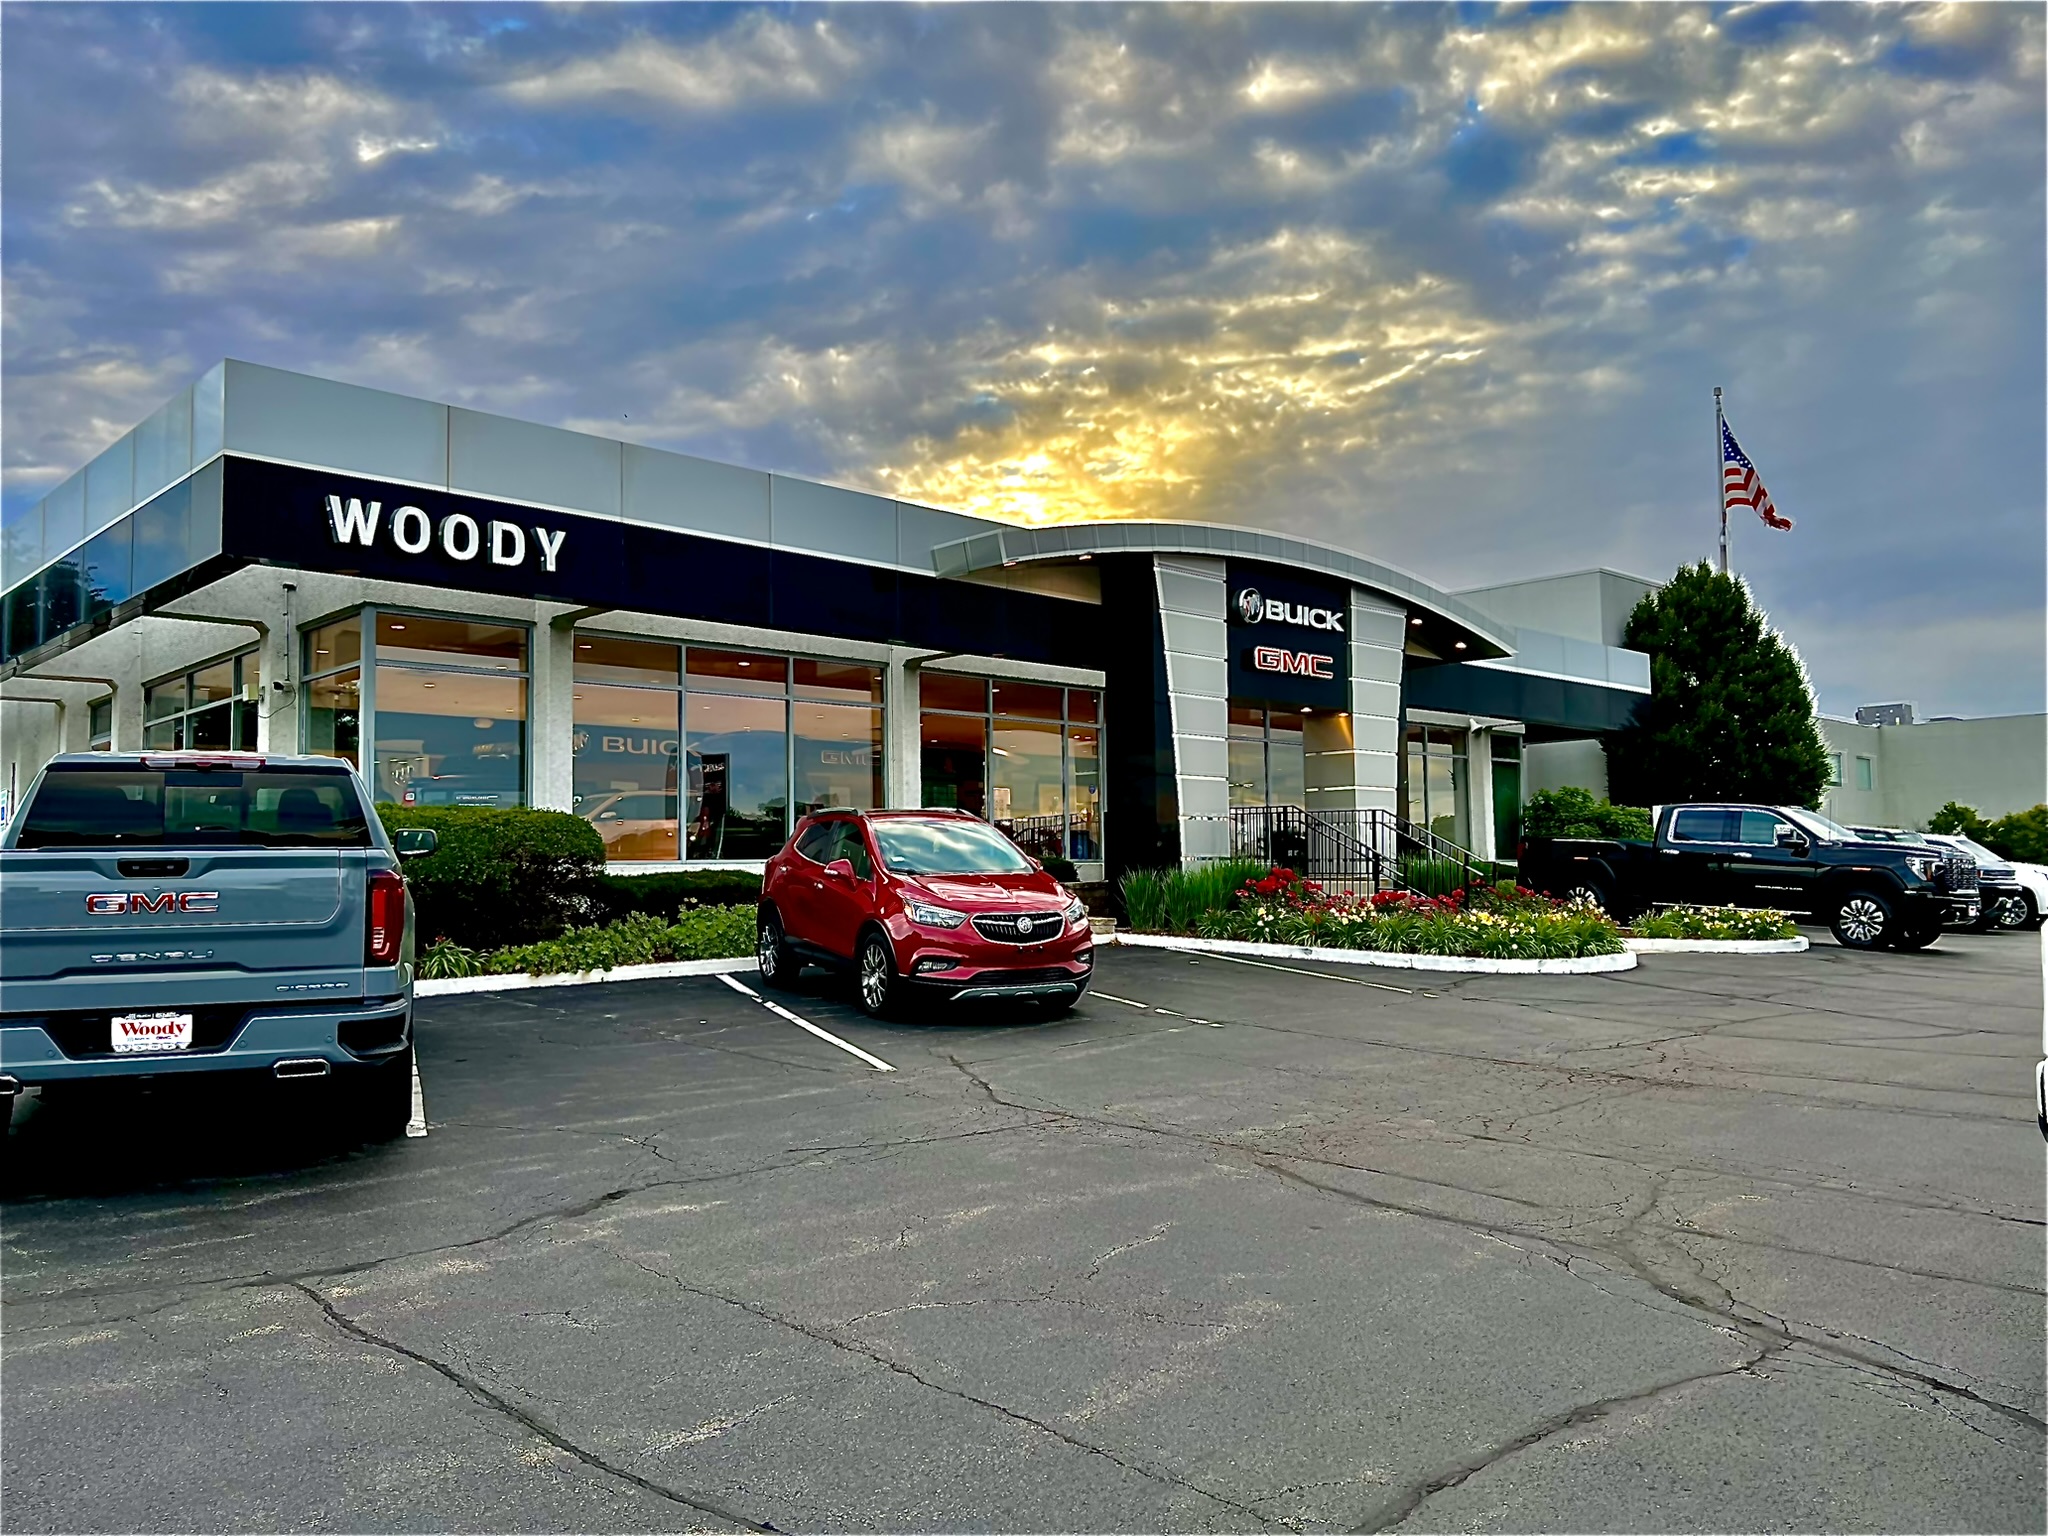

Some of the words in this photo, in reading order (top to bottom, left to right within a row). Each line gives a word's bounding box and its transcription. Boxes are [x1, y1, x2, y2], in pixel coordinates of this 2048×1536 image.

[325, 494, 566, 572] WOODY
[1265, 599, 1344, 632] BUICK
[1254, 645, 1334, 679] GMC
[86, 891, 219, 915] GMC
[119, 1021, 187, 1037] Woody
